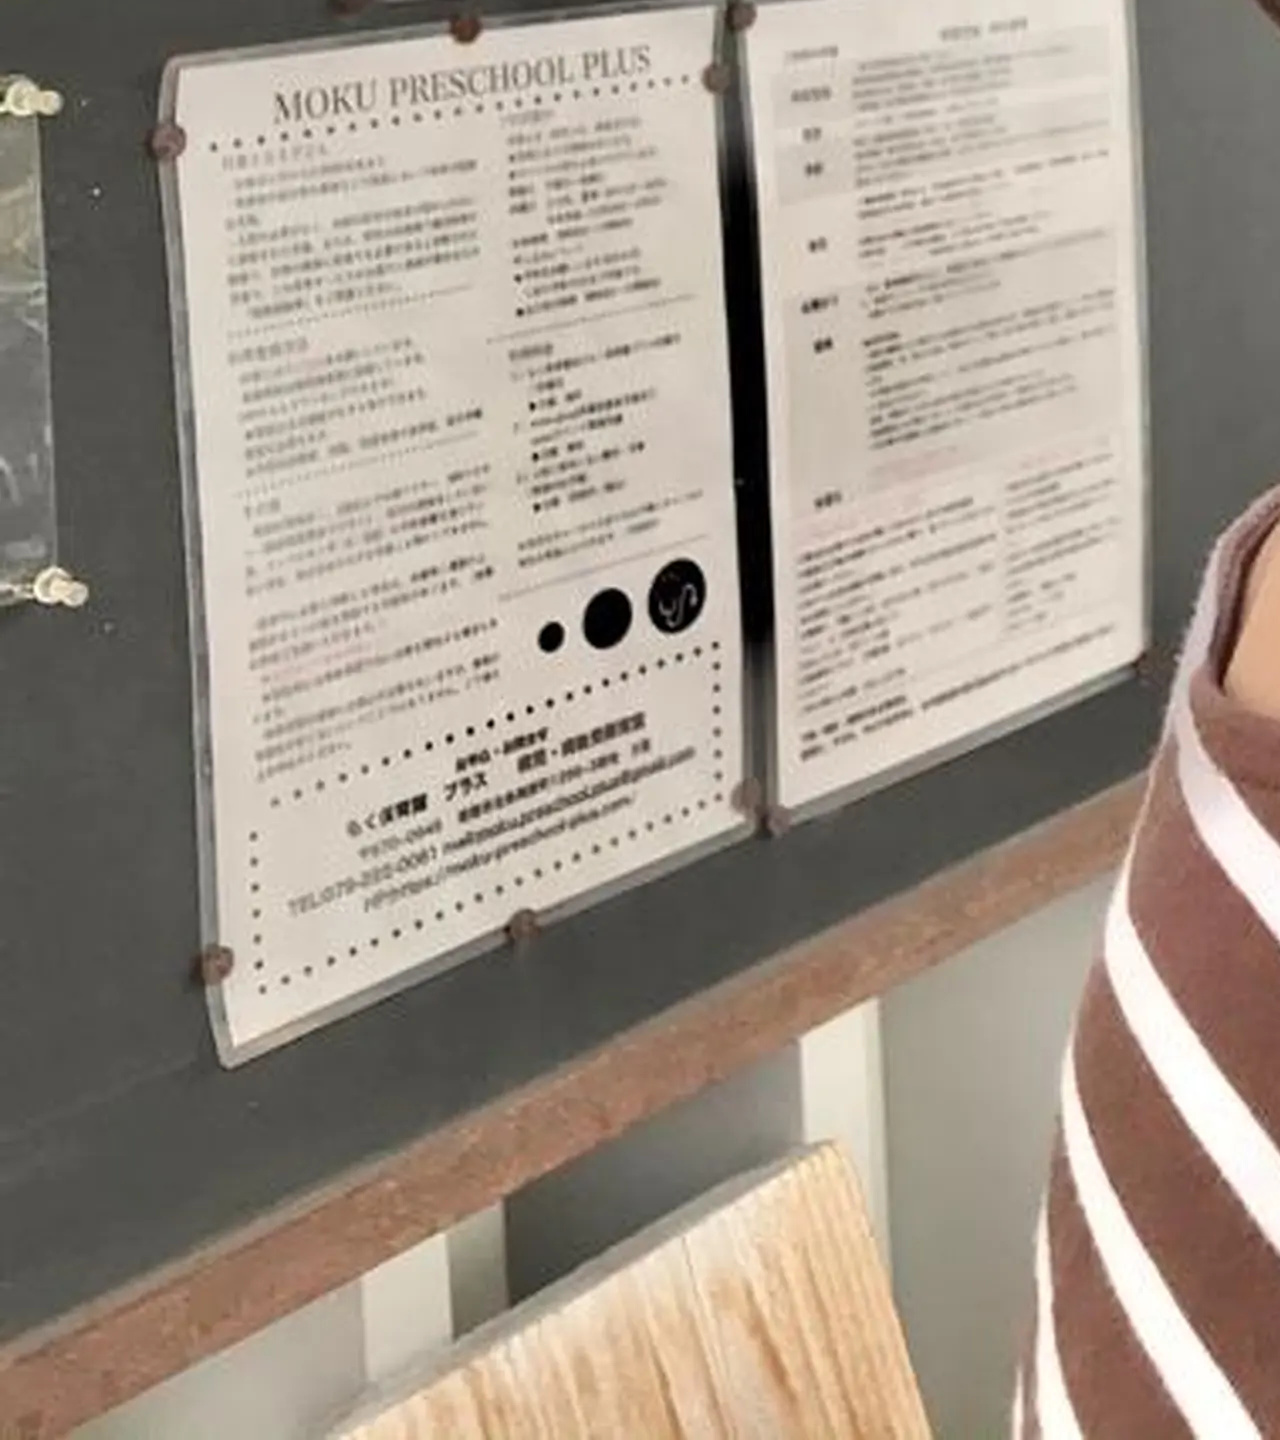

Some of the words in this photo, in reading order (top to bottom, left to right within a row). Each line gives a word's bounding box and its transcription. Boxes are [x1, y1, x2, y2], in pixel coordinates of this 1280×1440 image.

[273, 79, 377, 124] MOKU
[388, 56, 574, 107] PRESCHOOL
[582, 44, 652, 81] PLUS
